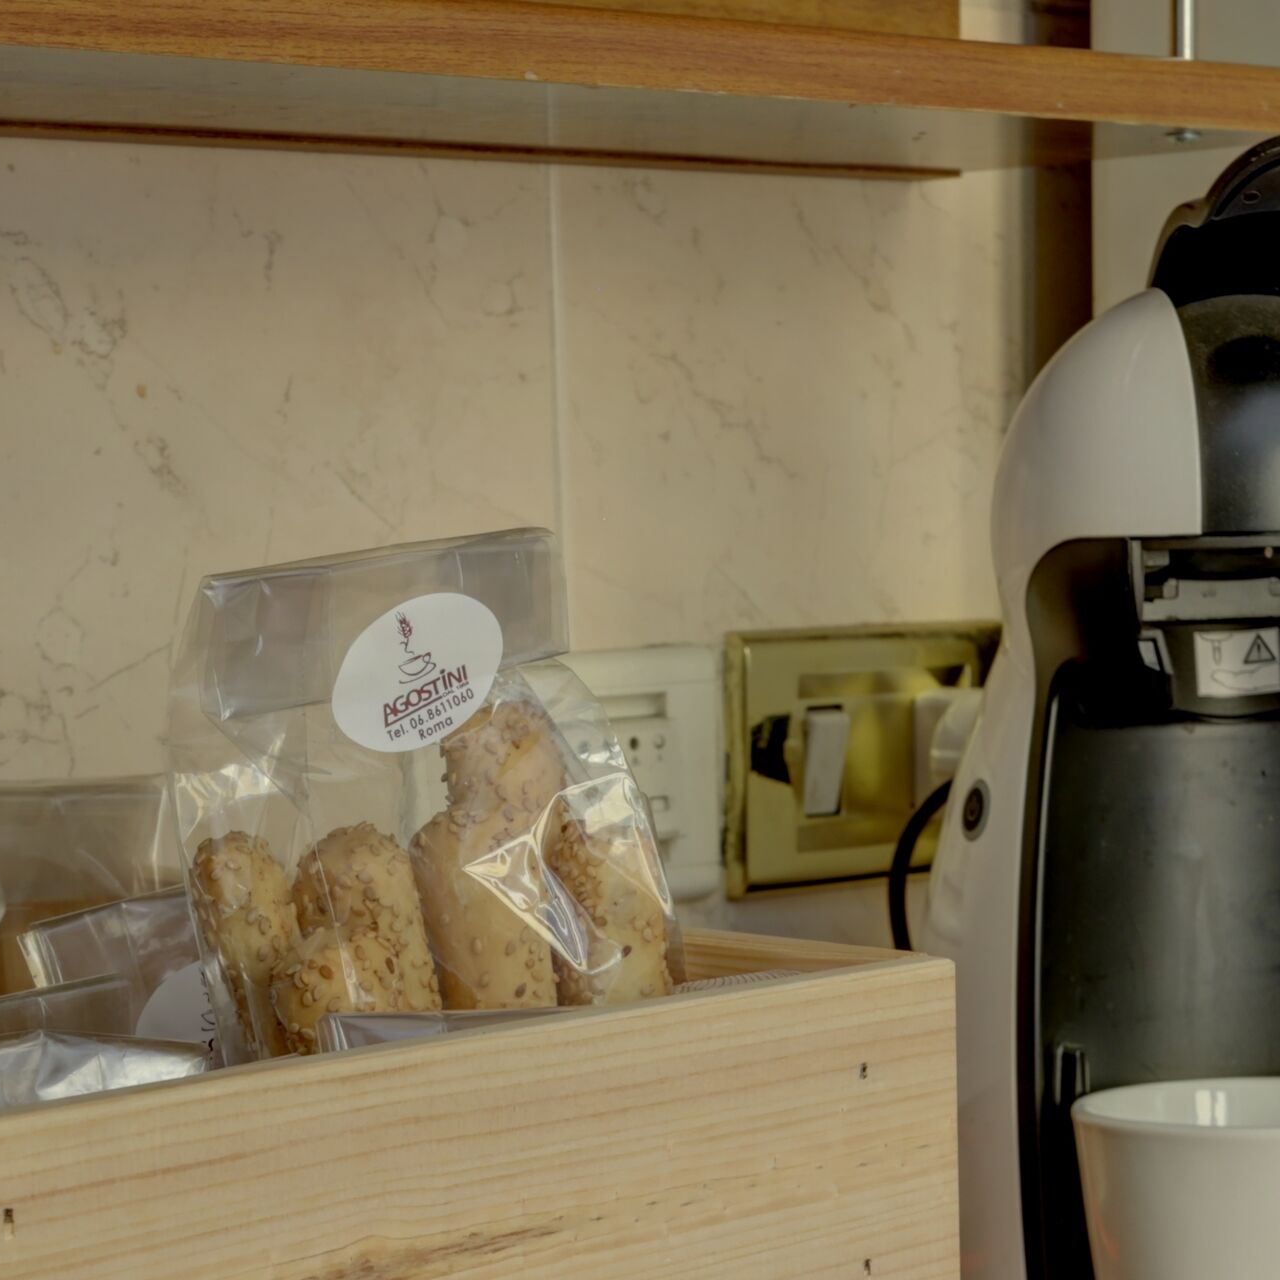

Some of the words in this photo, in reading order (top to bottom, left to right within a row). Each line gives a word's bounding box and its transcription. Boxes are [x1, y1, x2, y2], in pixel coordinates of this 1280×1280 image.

[387, 724, 409, 741] Tel.
[410, 688, 474, 729] 06.8611060
[418, 716, 453, 740] Roma
